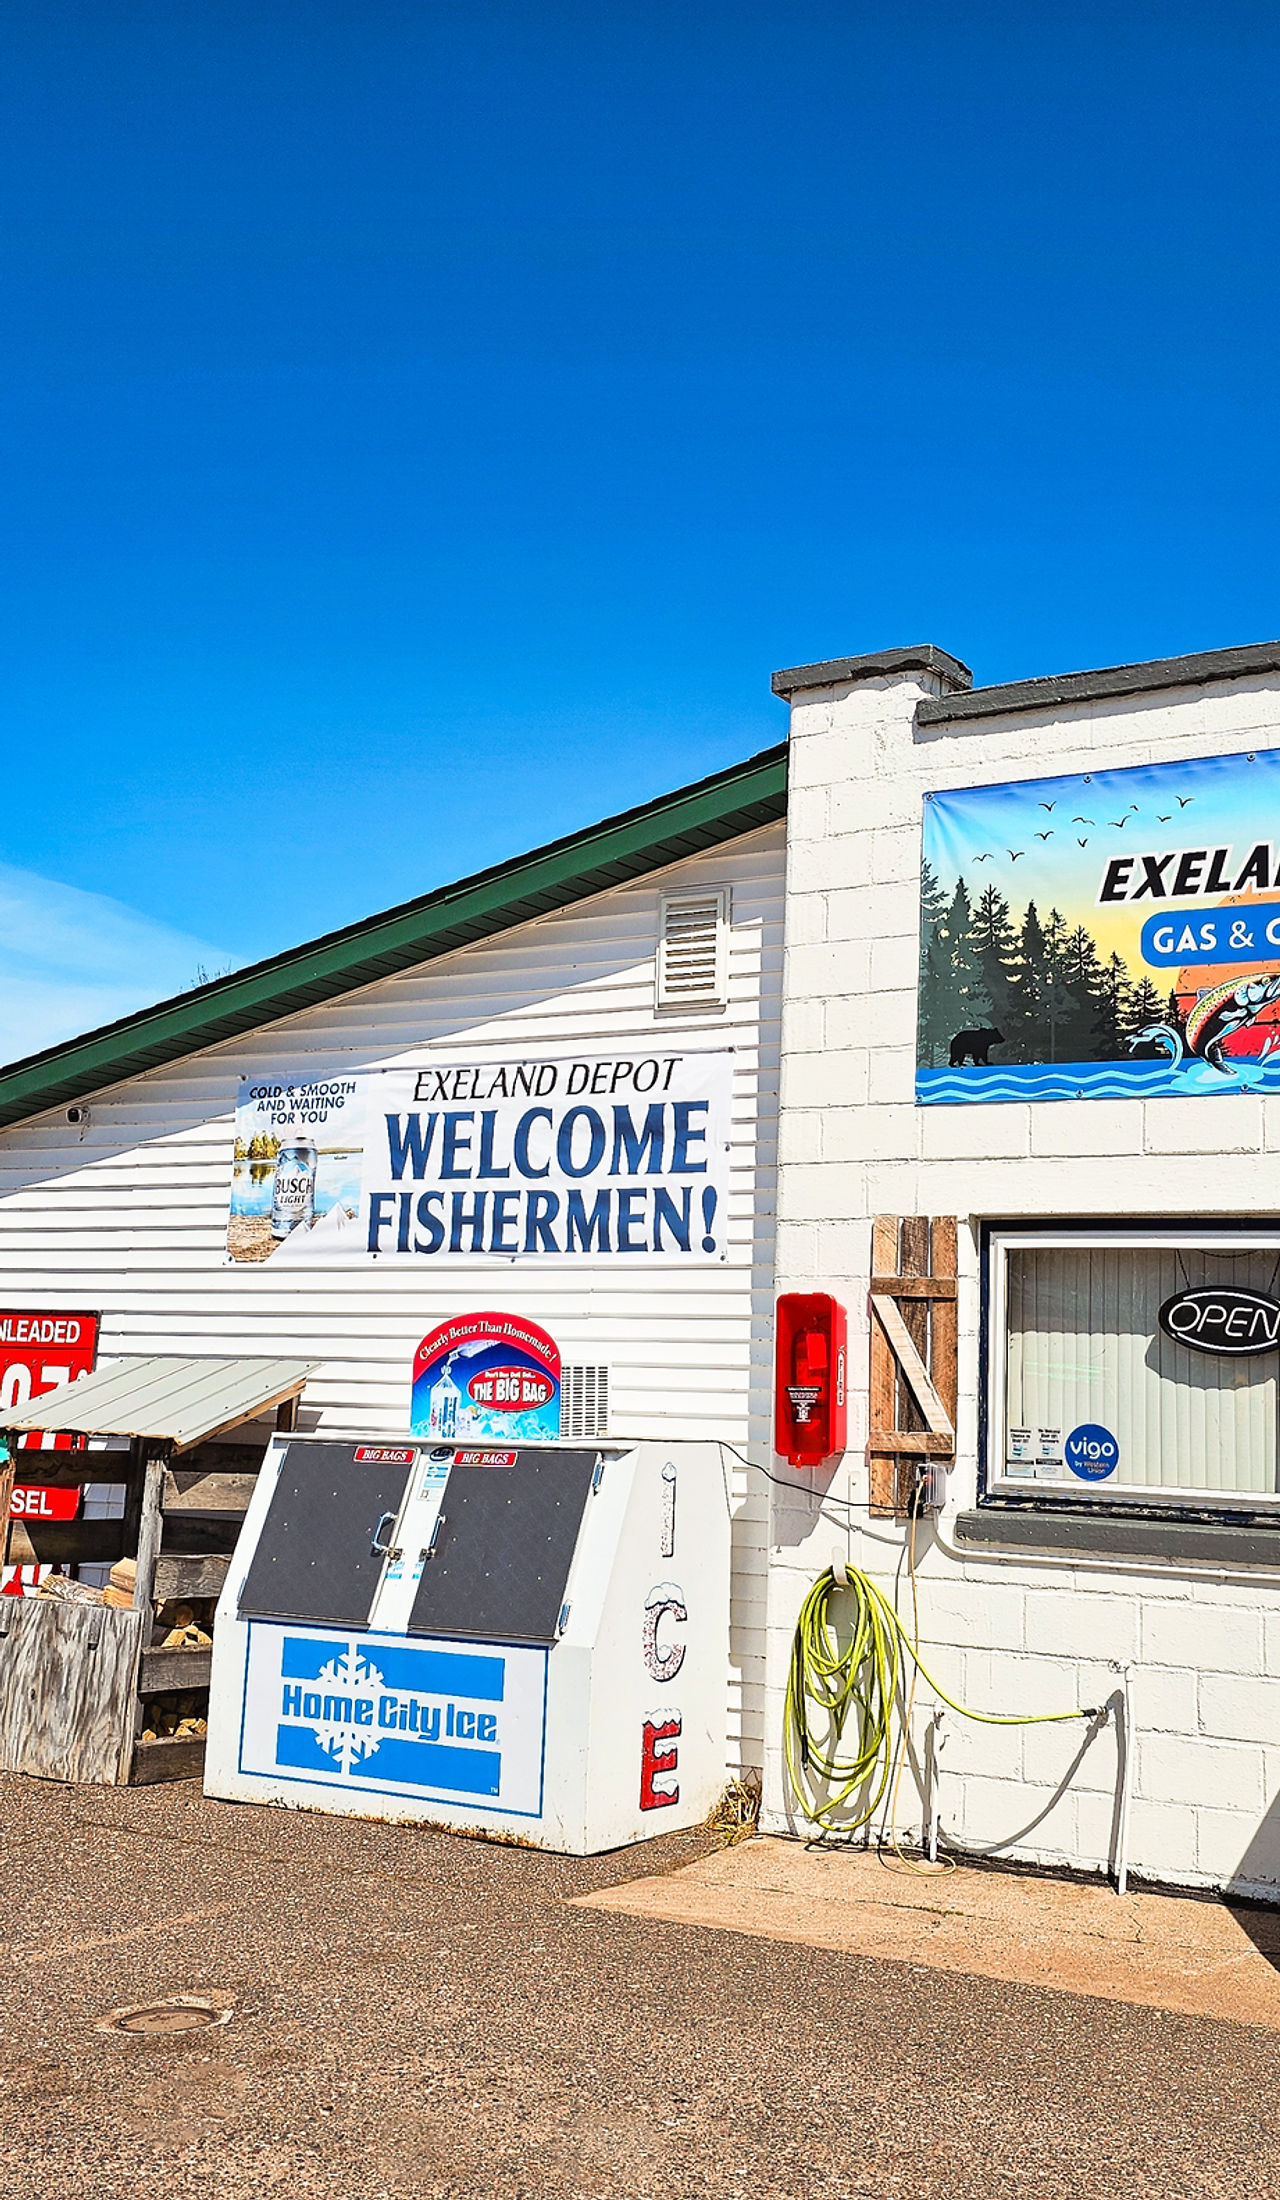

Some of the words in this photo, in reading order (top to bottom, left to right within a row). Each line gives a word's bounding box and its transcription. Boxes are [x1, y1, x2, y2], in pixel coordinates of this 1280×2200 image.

[1096, 840, 1280, 902] EXELA
[1153, 923, 1217, 954] GAS
[1229, 920, 1254, 949] &
[250, 1085, 282, 1099] COLD
[286, 1085, 295, 1097] &
[300, 1081, 356, 1097] SMOOTH
[413, 1064, 558, 1101] EXELAND
[566, 1058, 683, 1096] DEPOT
[257, 1099, 285, 1112] AND
[290, 1096, 345, 1110] WAITING
[271, 1112, 295, 1125] FOR
[300, 1110, 328, 1123] YOU
[384, 1100, 710, 1181] WELCOME
[276, 1178, 313, 1195] BUSCH
[280, 1195, 306, 1204] LIGHT
[367, 1185, 718, 1254] FISHERMEN!
[1168, 1301, 1280, 1340] OPEN
[419, 1332, 450, 1361] Clearly
[449, 1324, 478, 1340] Better
[478, 1320, 502, 1333] Than
[473, 1381, 494, 1401] THE
[495, 1378, 520, 1402] BIG
[522, 1380, 547, 1402] BAG
[361, 1449, 380, 1460] BIG
[381, 1450, 409, 1461] BAGS
[461, 1452, 480, 1463] BIG
[481, 1453, 509, 1465] BAGS
[1070, 1436, 1115, 1460] vigo
[282, 1684, 374, 1726] Home
[377, 1695, 442, 1742] City
[445, 1702, 498, 1743] Ice
